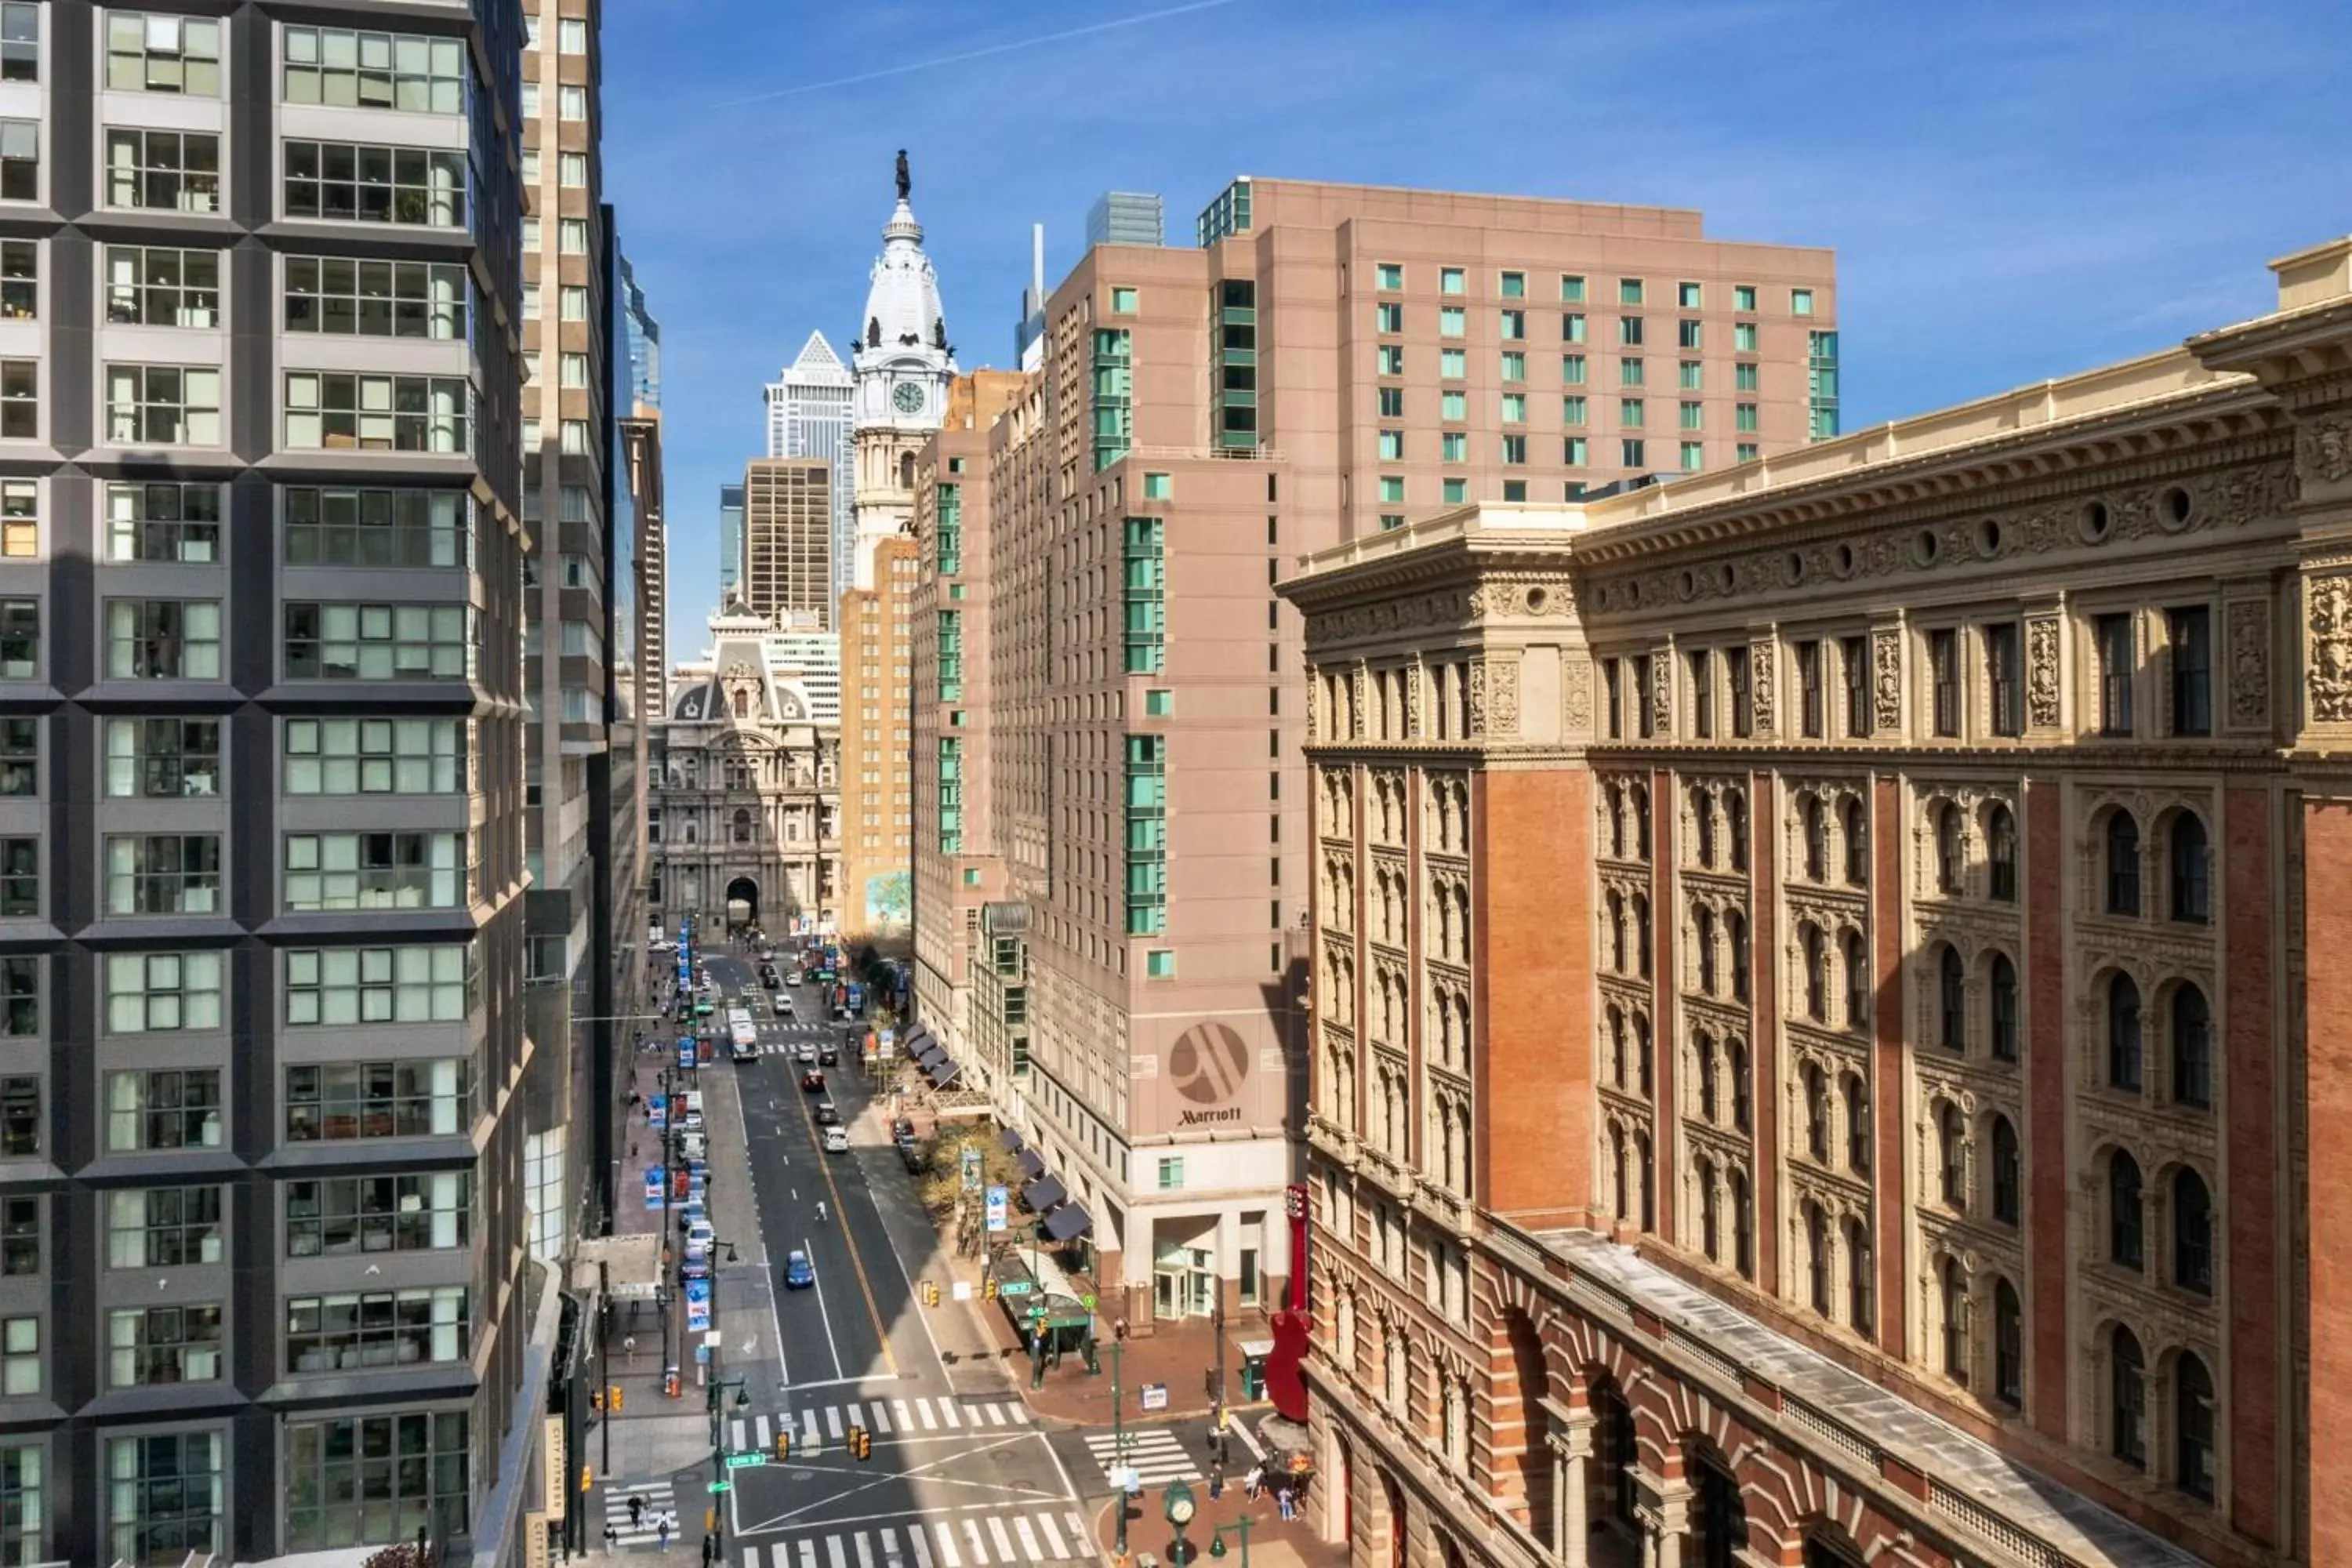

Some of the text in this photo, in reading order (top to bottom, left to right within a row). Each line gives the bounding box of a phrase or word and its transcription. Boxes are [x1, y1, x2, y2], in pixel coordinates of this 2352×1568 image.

[1177, 1107, 1241, 1126] Marriott
[552, 1427, 562, 1508] CITY FITNESS
[534, 1522, 544, 1550] CITY
